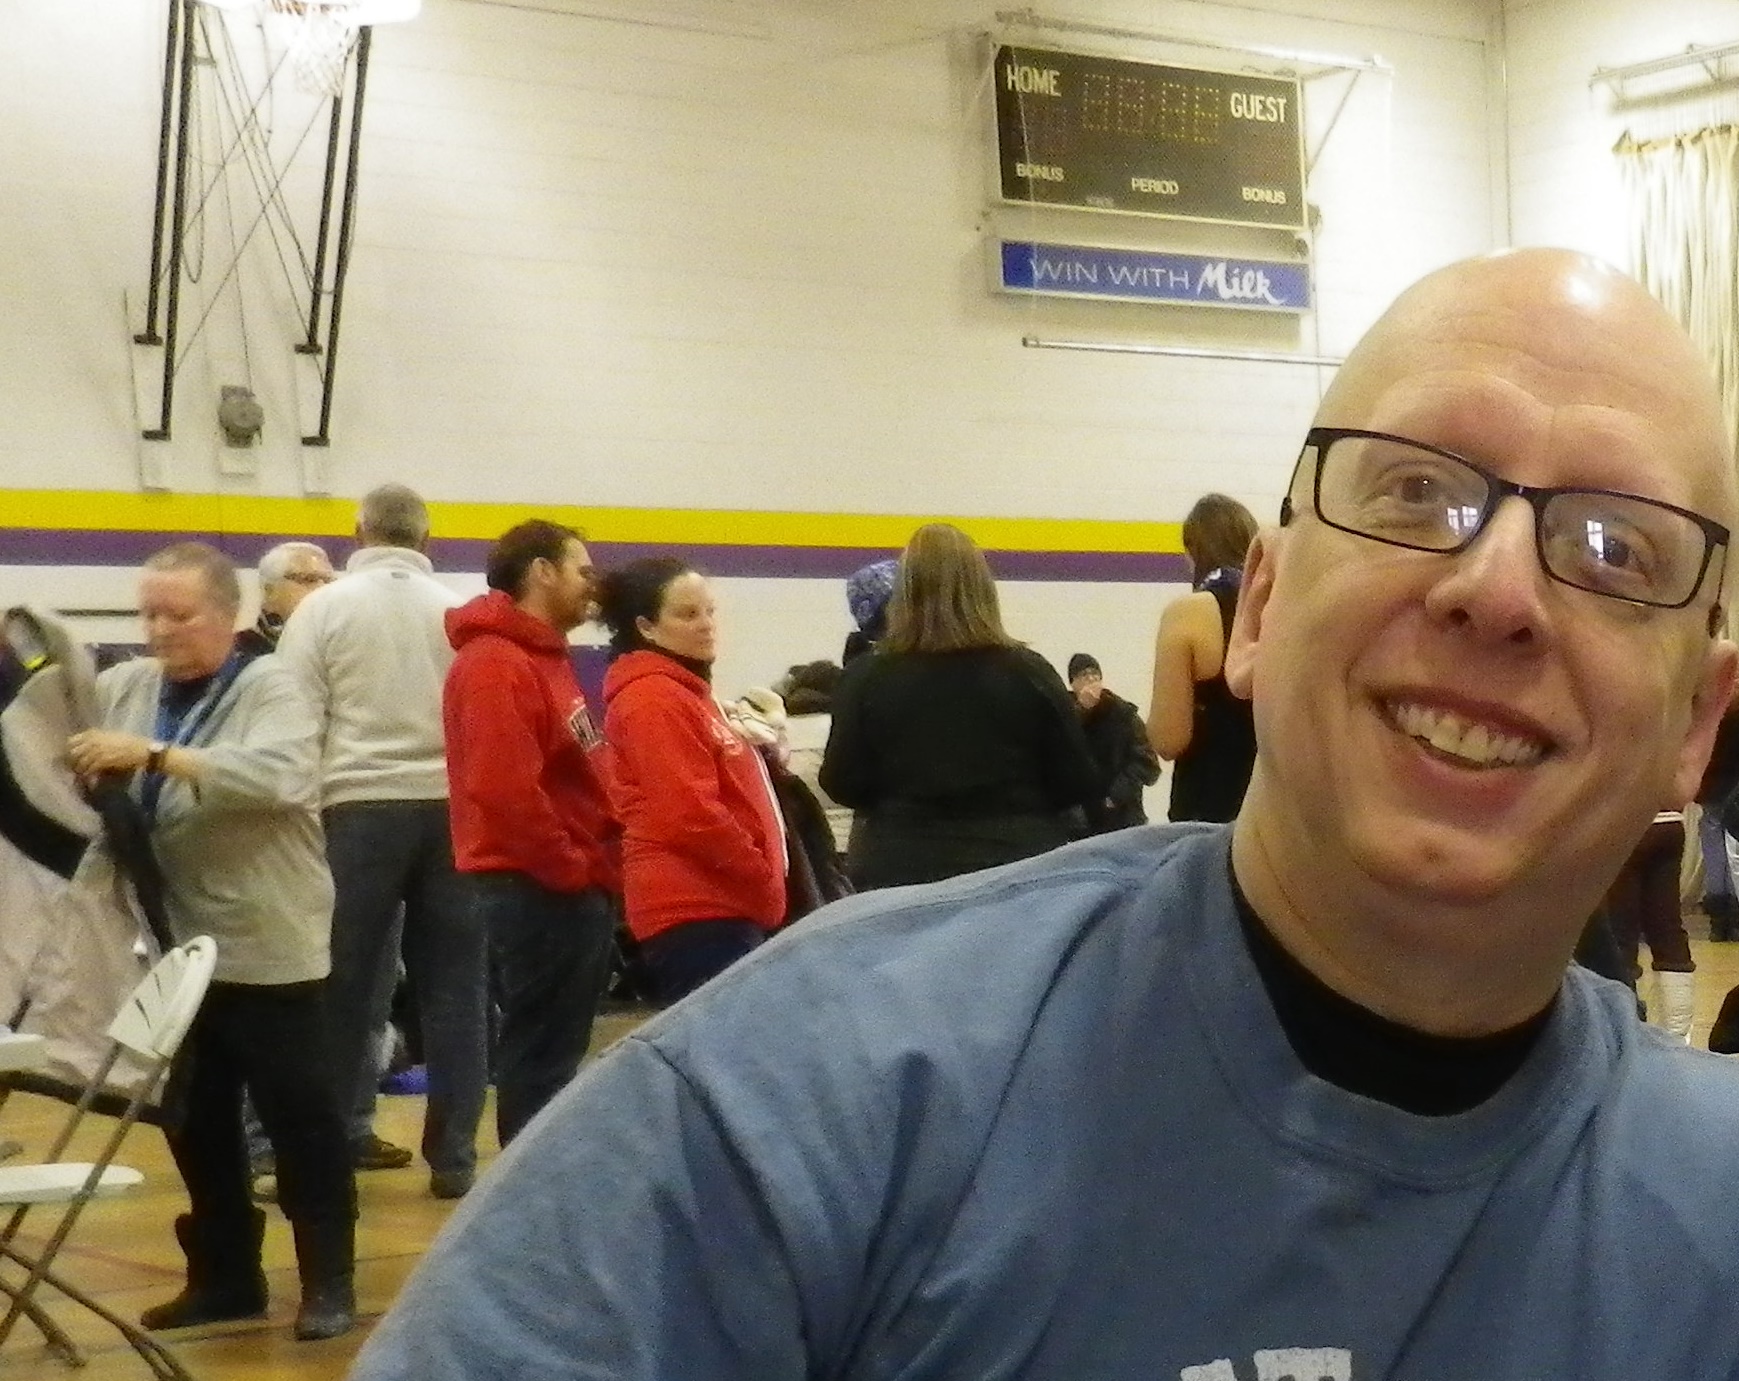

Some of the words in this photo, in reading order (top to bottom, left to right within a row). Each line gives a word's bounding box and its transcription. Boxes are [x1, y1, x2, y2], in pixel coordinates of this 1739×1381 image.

[1006, 64, 1062, 97] HOME
[1230, 92, 1287, 123] GUEST
[1016, 162, 1065, 182] BONUS
[1131, 177, 1179, 195] PERIOD
[1242, 186, 1286, 204] BONUS
[1030, 258, 1098, 284] WIN
[1108, 264, 1190, 290] WITH
[1197, 261, 1283, 305] Milk
